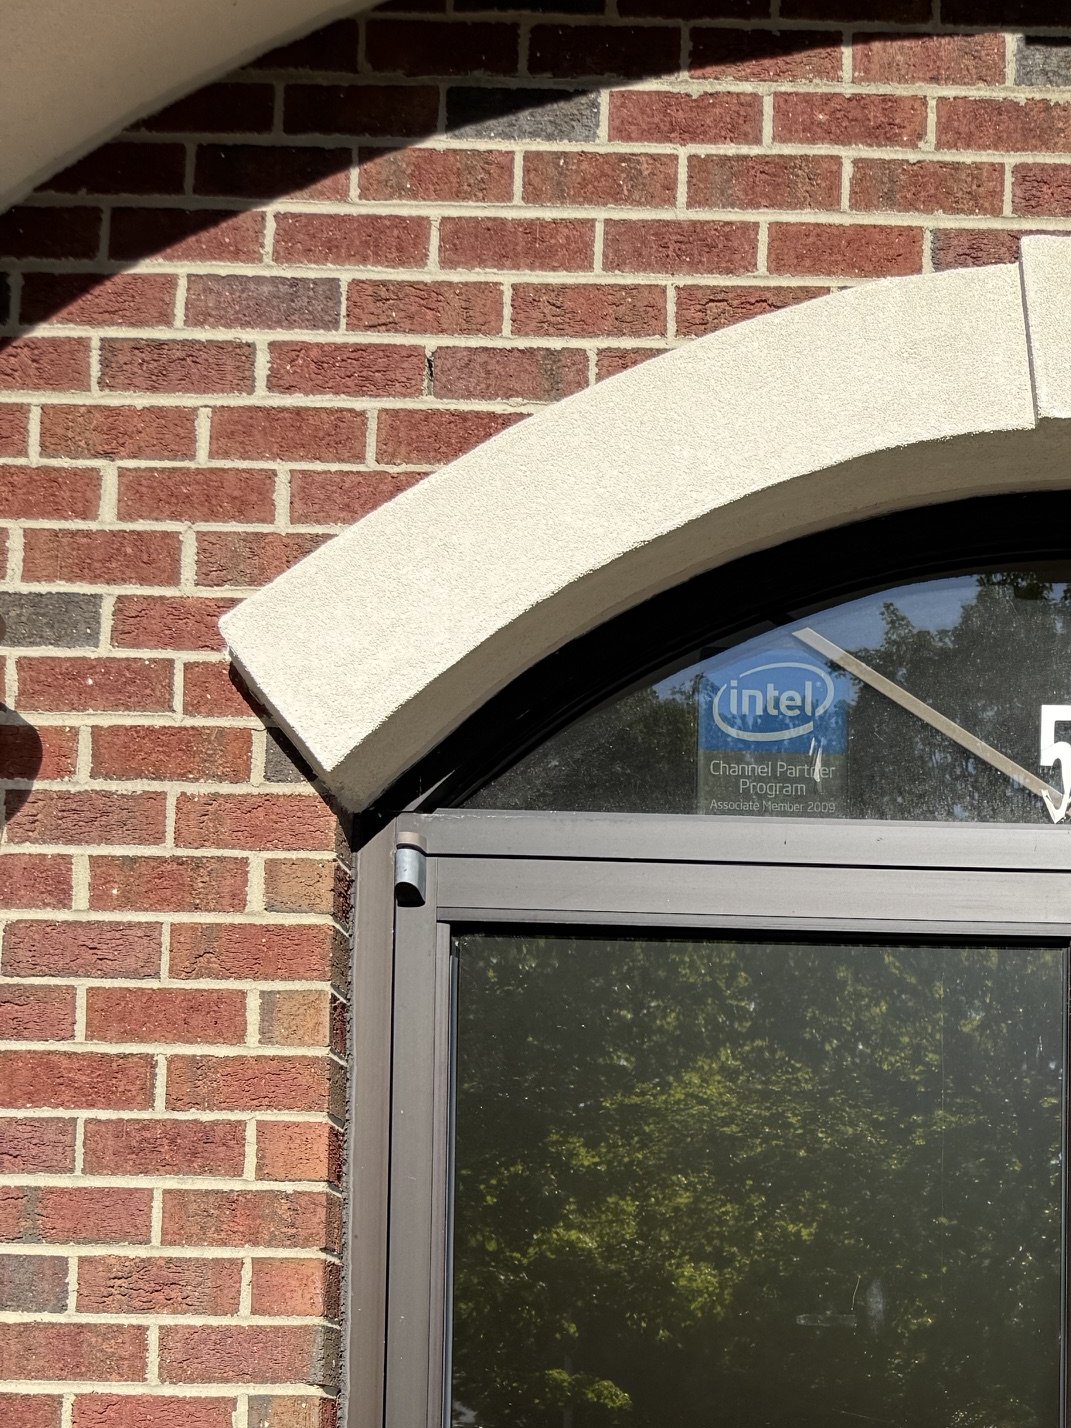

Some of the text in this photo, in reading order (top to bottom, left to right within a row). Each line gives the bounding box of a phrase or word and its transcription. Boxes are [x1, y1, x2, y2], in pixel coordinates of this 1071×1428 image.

[730, 679, 813, 717] intel
[709, 760, 836, 779] Channel Partner
[739, 779, 807, 798] Program
[709, 799, 836, 813] Associate Member 2009
